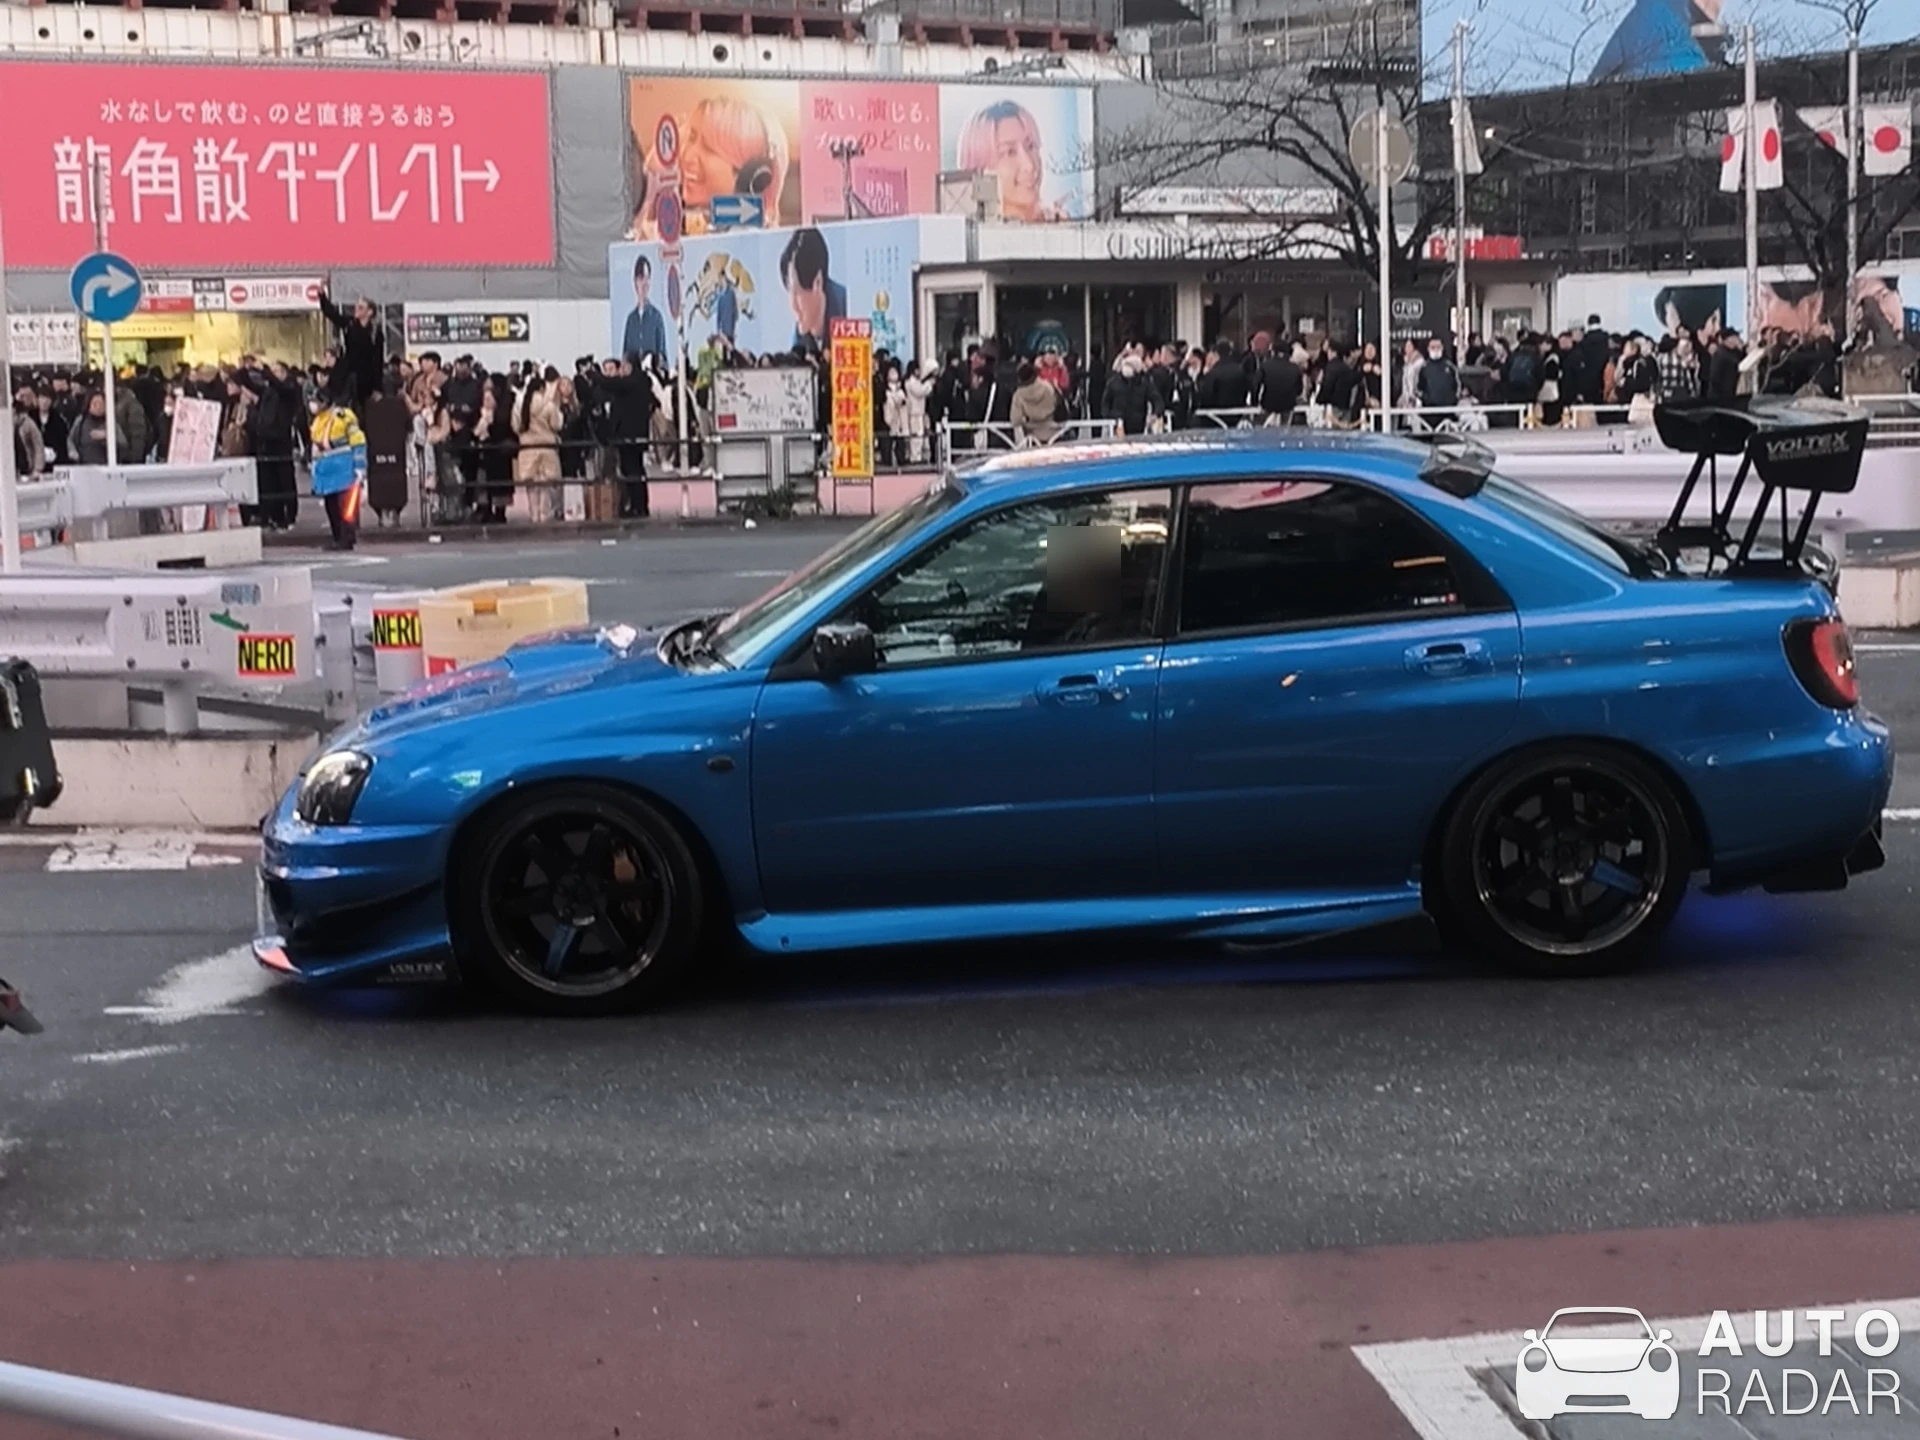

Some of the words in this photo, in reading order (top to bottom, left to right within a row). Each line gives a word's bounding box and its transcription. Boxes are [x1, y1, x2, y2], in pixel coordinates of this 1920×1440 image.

[101, 98, 456, 128] 水なしで飲む、のど直接うるおう
[834, 343, 861, 469] 駐停車禁止
[1766, 431, 1848, 455] VOLTEX
[238, 638, 294, 672] NERO
